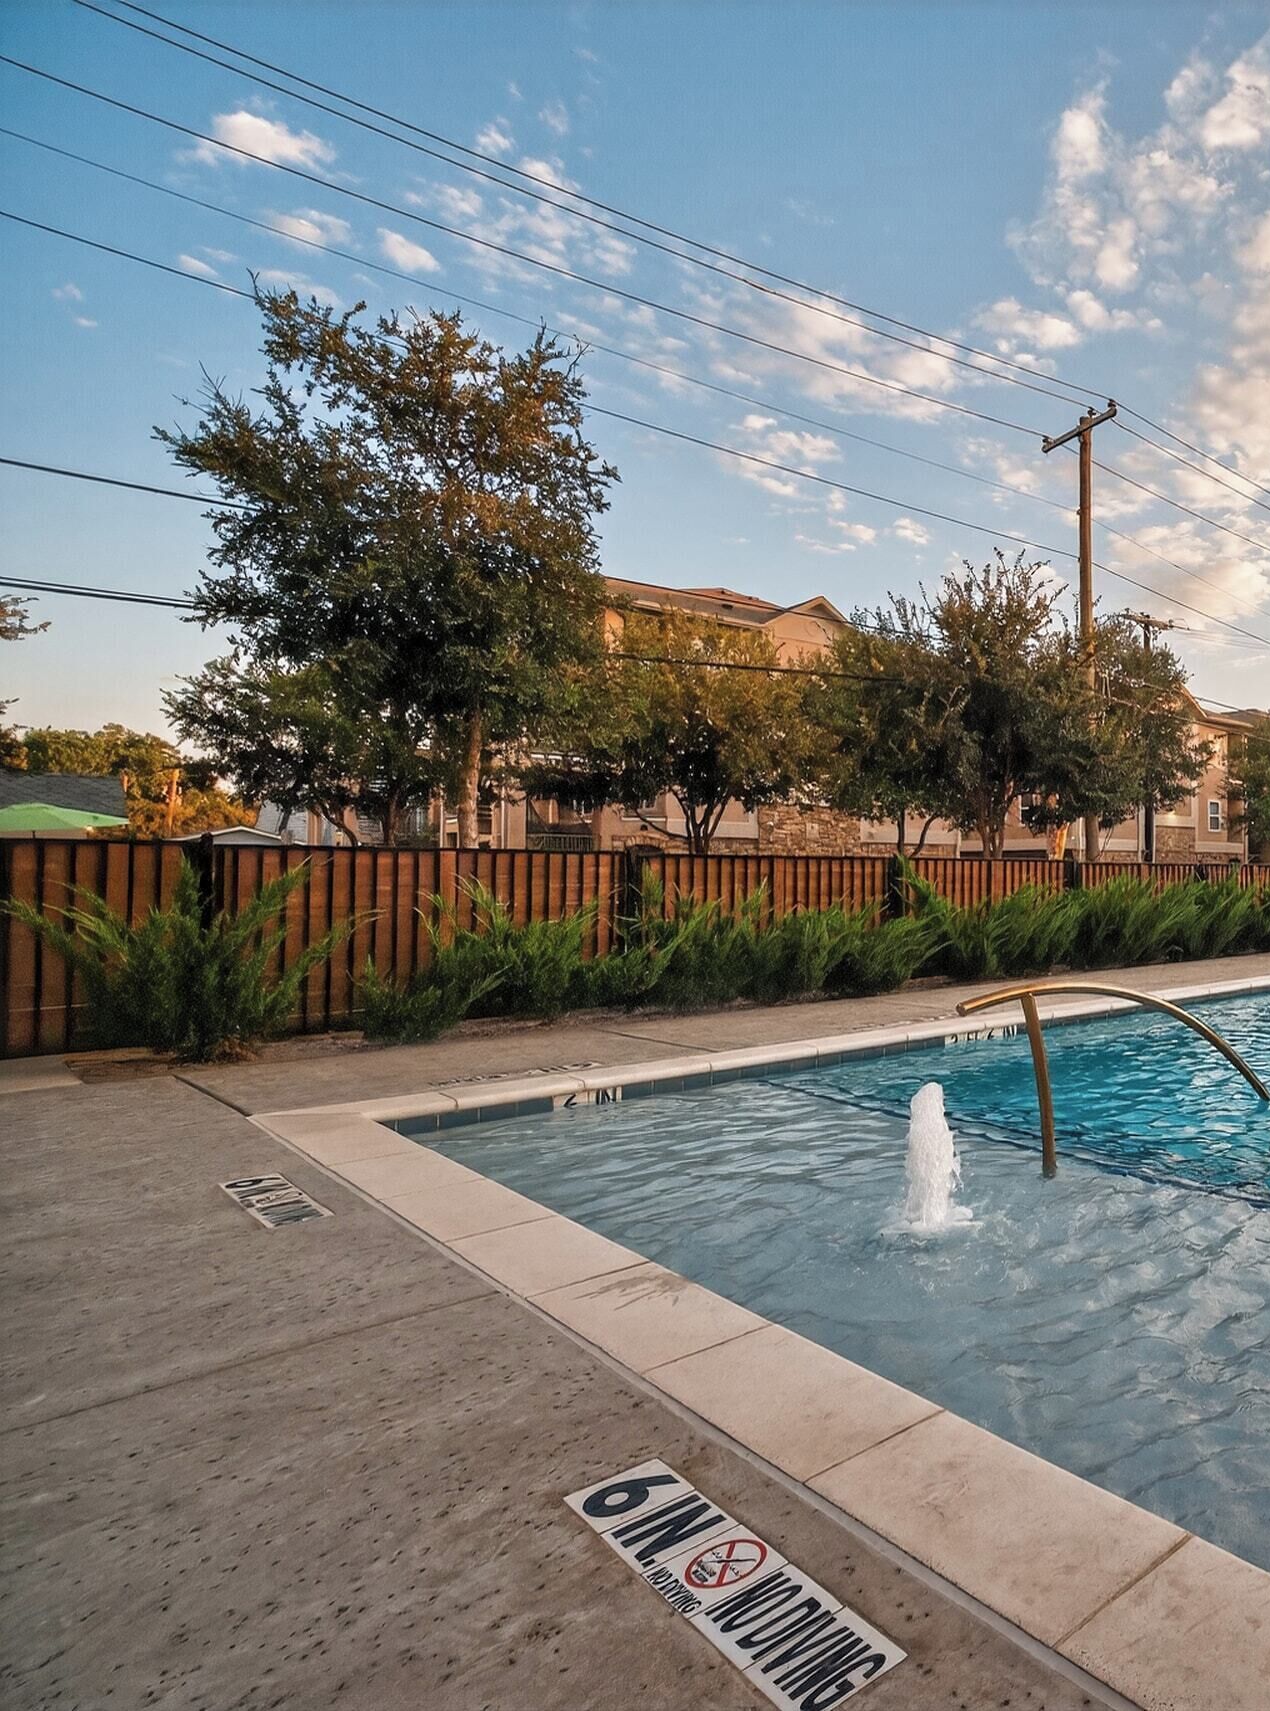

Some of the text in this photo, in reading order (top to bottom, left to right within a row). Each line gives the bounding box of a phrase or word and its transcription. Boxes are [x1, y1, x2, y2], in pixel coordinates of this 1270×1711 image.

[582, 1474, 681, 1518] 6
[704, 1571, 804, 1634] NO
[735, 1596, 887, 1711] DIVING
